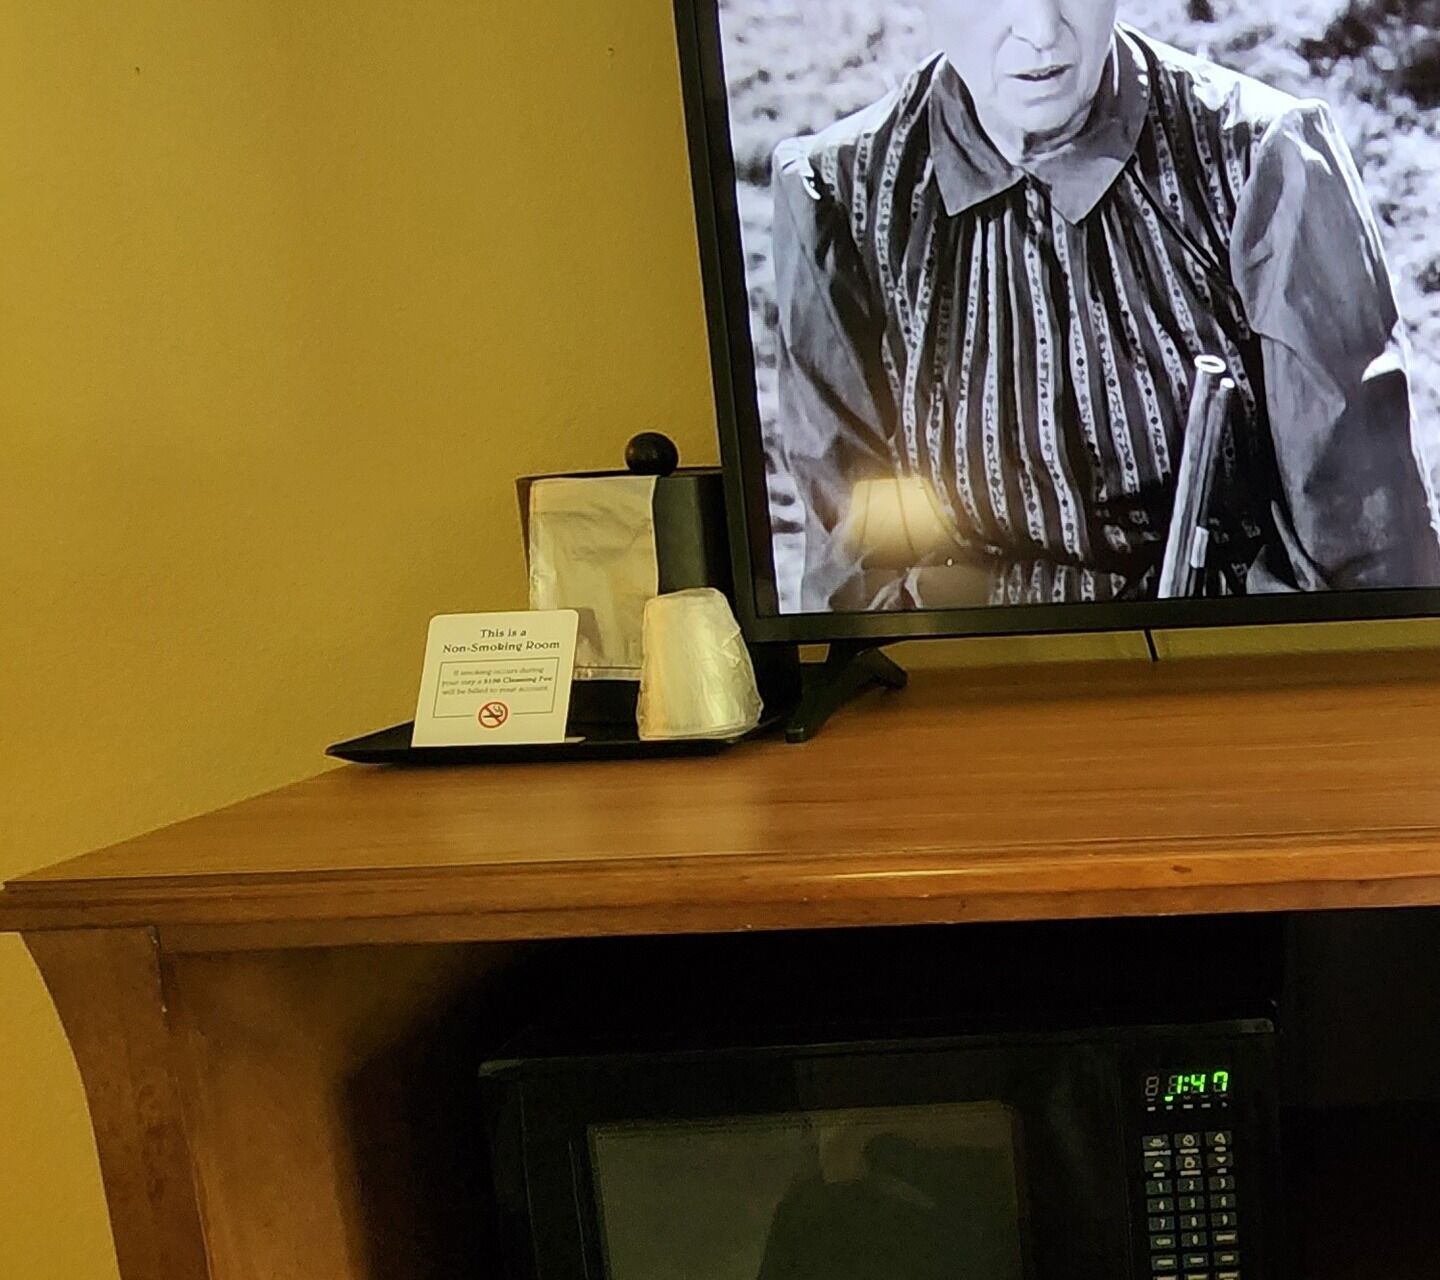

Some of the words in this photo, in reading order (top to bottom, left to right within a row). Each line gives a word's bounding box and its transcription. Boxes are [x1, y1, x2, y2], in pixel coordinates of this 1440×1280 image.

[480, 628, 504, 638] This
[508, 628, 518, 637] is
[520, 629, 527, 637] a
[442, 642, 523, 653] Non-Smoking
[526, 640, 560, 650] Room
[1177, 1071, 1228, 1094] 1:47
